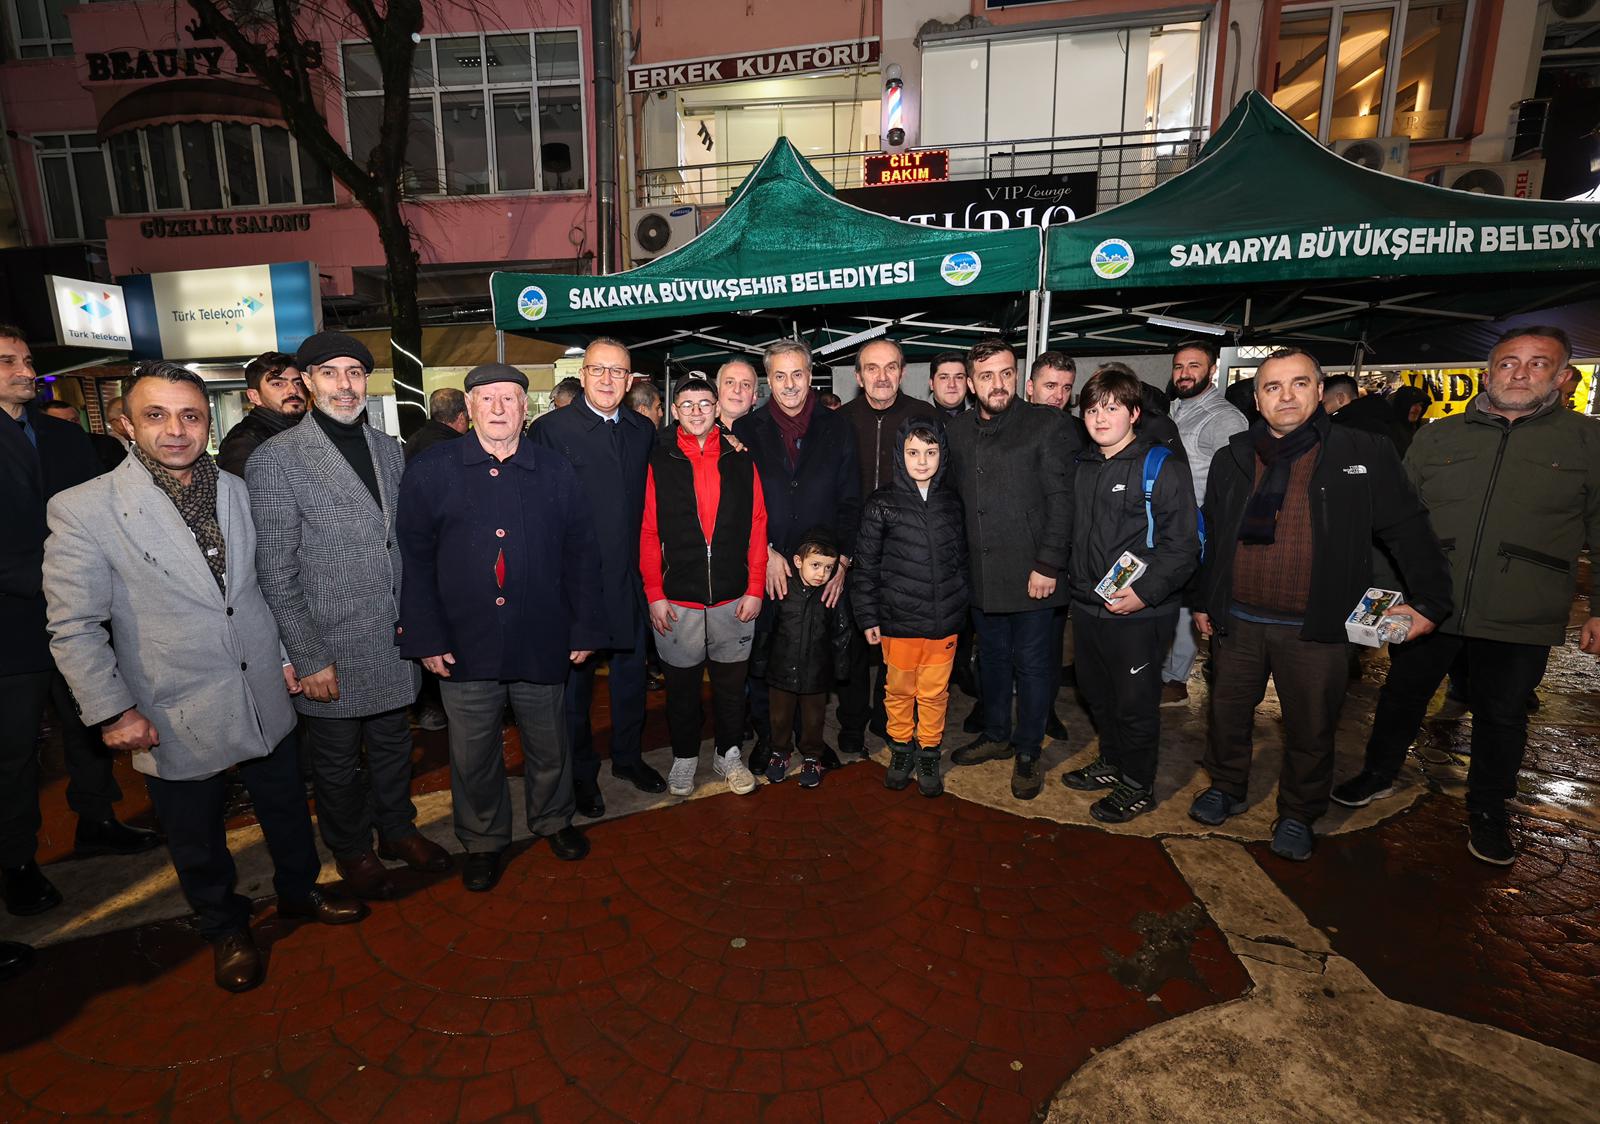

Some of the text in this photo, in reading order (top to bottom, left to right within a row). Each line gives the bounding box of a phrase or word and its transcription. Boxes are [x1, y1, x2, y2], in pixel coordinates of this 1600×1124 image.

[85, 46, 224, 81] BEAUTY
[634, 42, 870, 89] ERKEK KUAFÖRÜ
[881, 167, 929, 182] BAKIM
[985, 184, 1073, 203] VIP Lounge
[140, 213, 311, 239] GÜZELLİK SALONU
[889, 202, 1077, 231] TUDIO
[1169, 217, 1600, 268] SAKARYA BÜYÜKŞEHİR BELEDİY
[569, 283, 659, 310] SAKARYA
[172, 306, 245, 322] Türk Telekom
[69, 329, 127, 343] Türk Telekom
